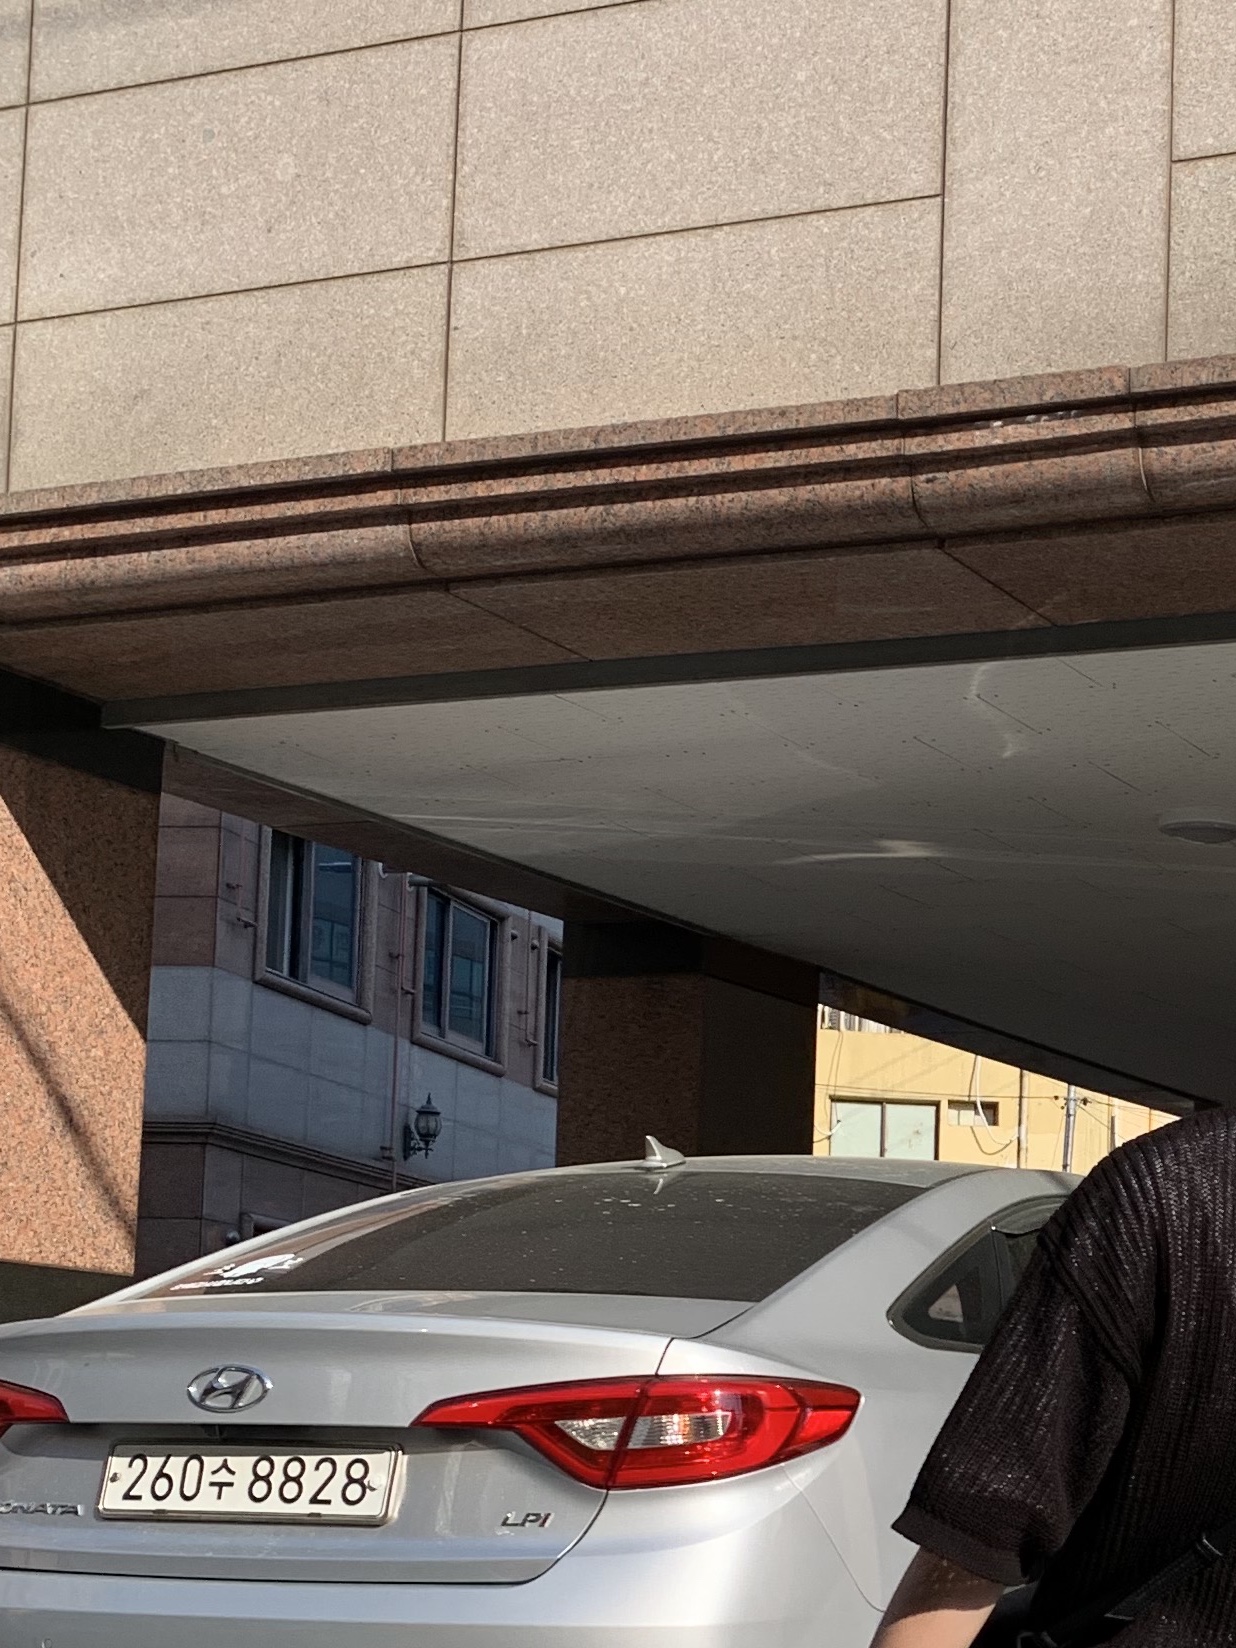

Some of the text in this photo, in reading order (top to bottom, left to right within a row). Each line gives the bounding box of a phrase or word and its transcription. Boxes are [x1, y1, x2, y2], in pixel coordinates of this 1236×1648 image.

[120, 1452, 371, 1507] 260수 8828
[501, 1510, 555, 1529] LPI
